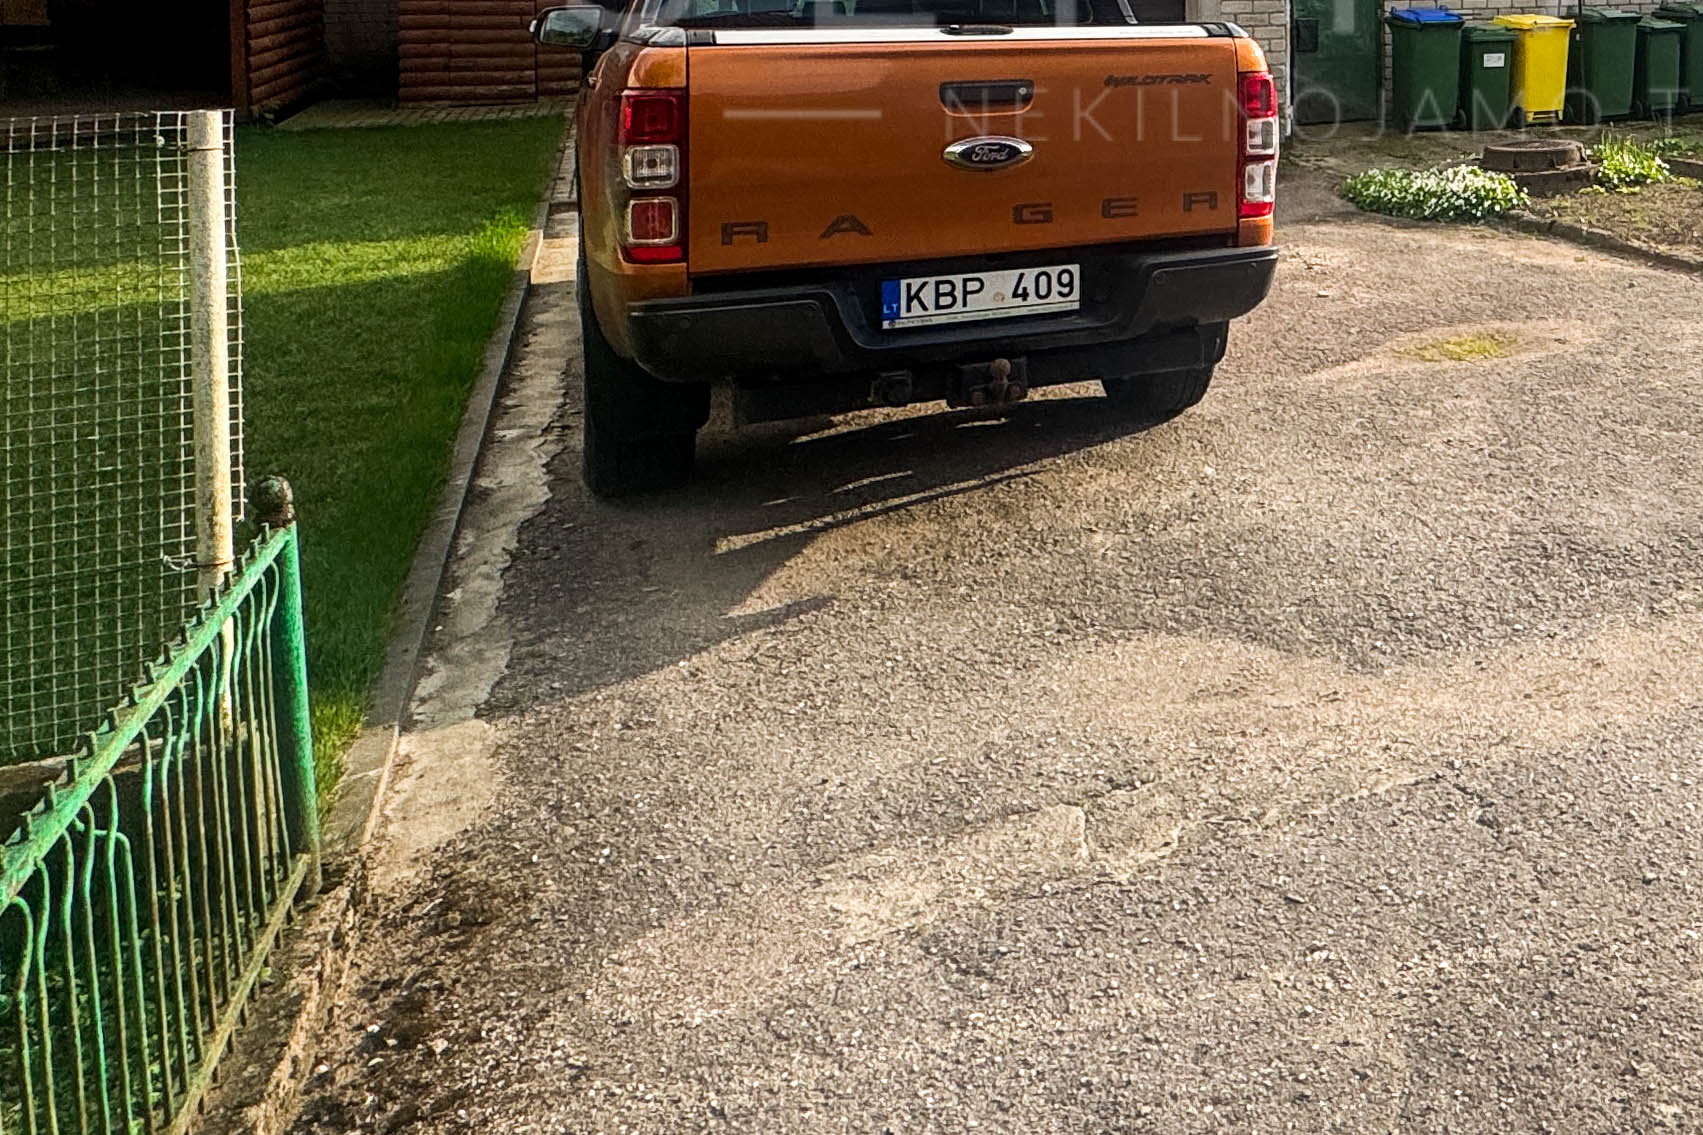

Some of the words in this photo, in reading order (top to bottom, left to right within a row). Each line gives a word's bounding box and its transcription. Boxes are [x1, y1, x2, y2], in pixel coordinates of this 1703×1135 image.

[971, 144, 1009, 162] Ford
[905, 277, 985, 313] KBP
[1012, 268, 1075, 302] 409
[883, 303, 898, 314] LT
